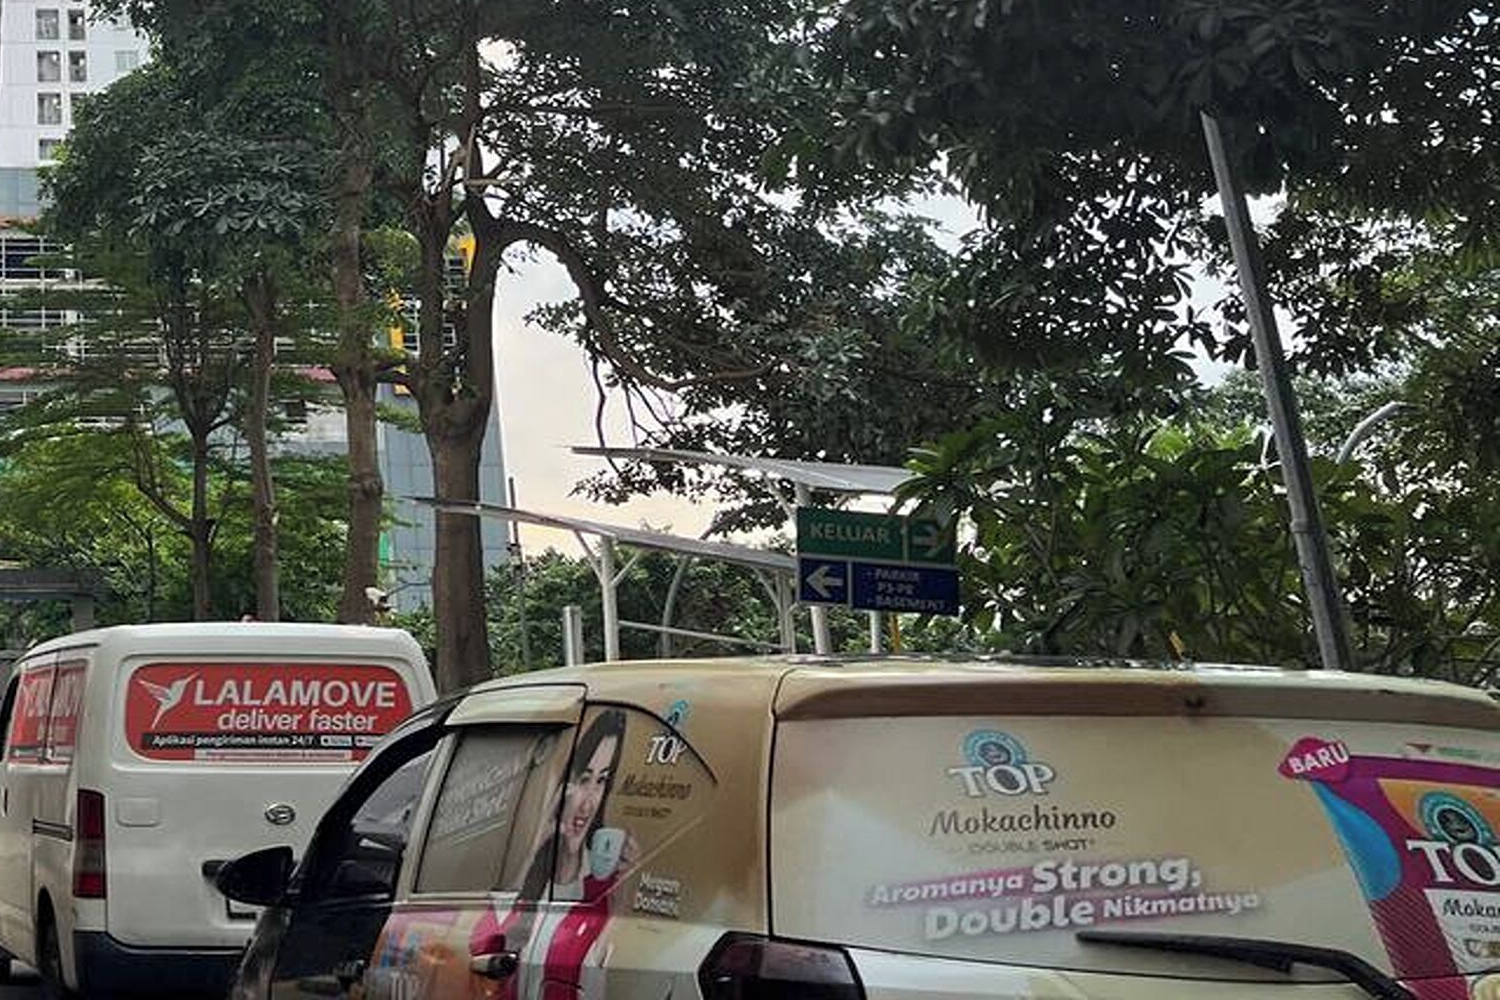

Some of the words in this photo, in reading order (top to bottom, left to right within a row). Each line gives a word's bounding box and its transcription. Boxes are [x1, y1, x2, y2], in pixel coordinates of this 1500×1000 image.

[809, 522, 891, 544] KELUAR
[194, 679, 396, 708] LALAMOVE
[217, 708, 302, 731] deliver
[309, 709, 378, 732] faster
[1287, 742, 1349, 774] BARU
[947, 764, 1055, 798] TOP
[928, 804, 1116, 837] Mokachinno
[1406, 839, 1500, 886] TO
[870, 873, 1024, 907] Aromanya
[1031, 856, 1201, 893] Strong,
[924, 897, 1096, 941] Double
[1102, 892, 1261, 920] Nikmatnya
[1442, 898, 1500, 918] Moka
